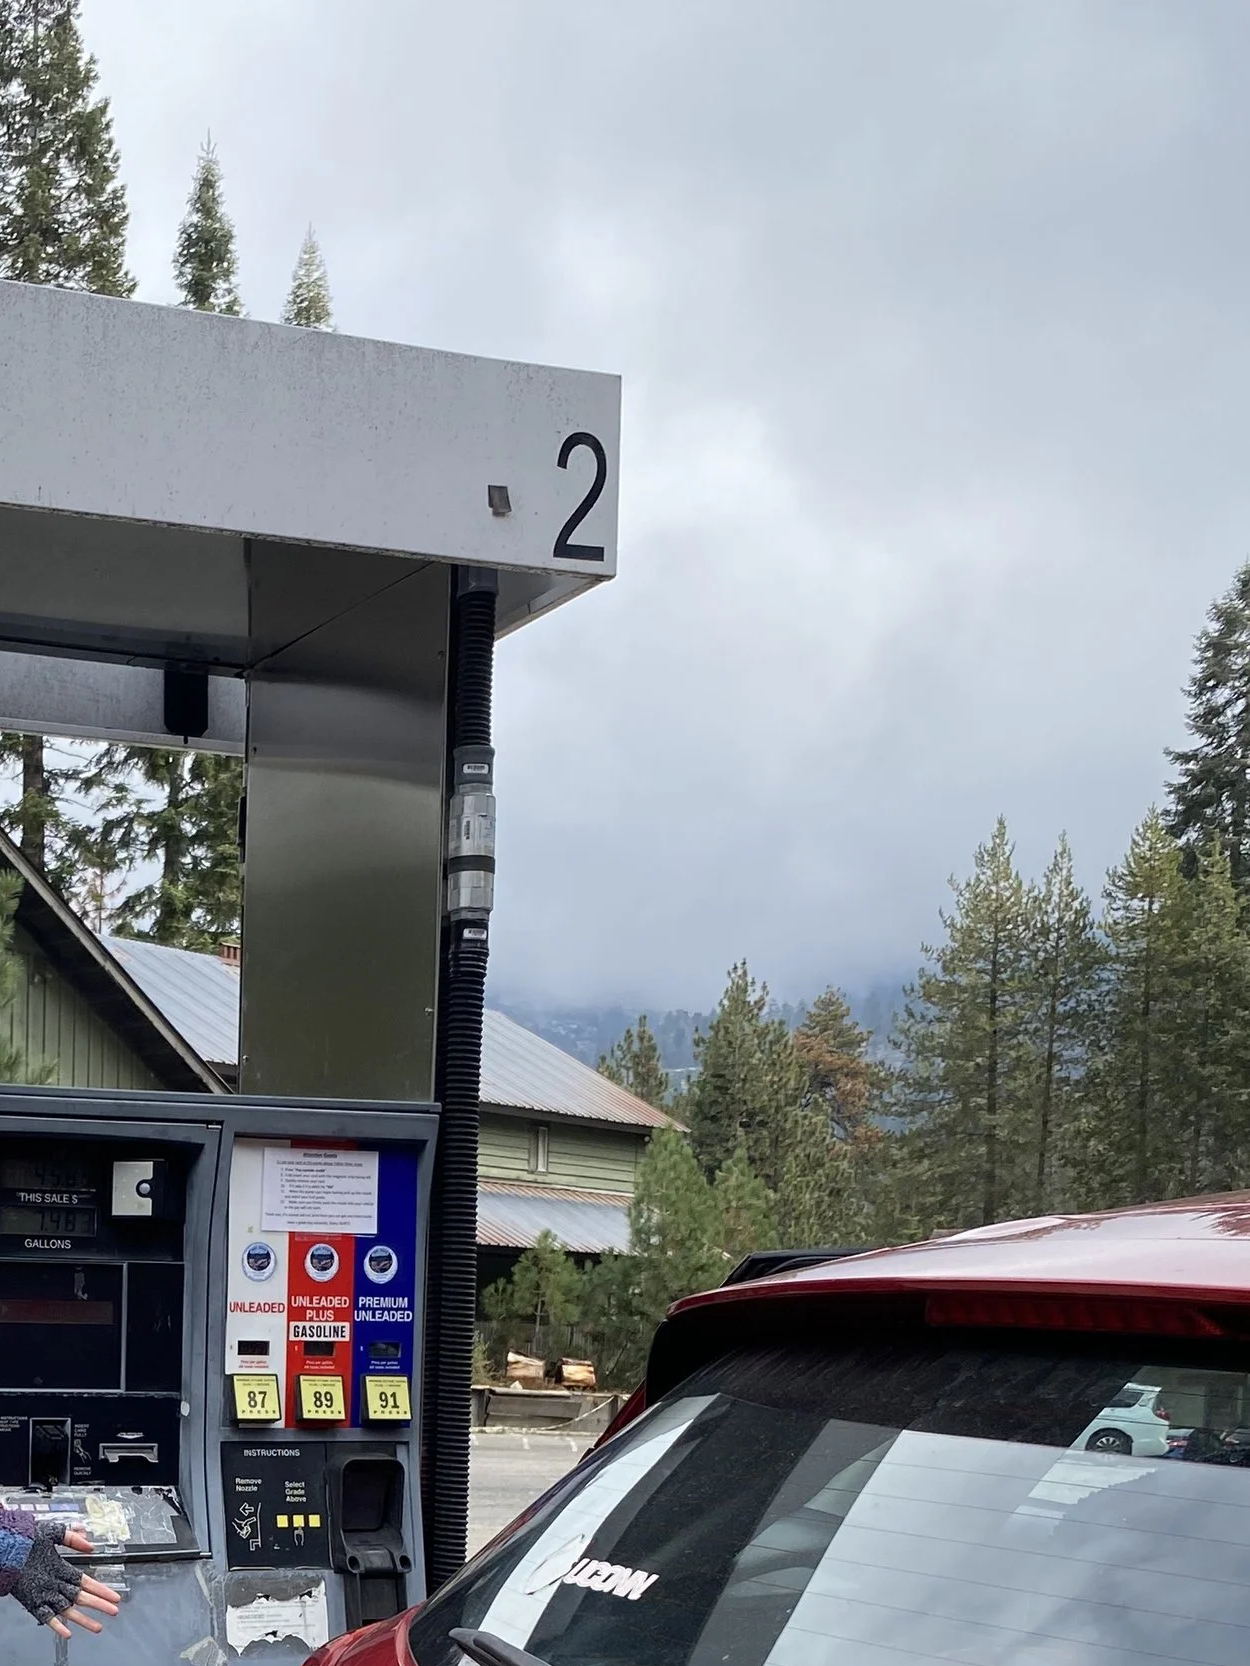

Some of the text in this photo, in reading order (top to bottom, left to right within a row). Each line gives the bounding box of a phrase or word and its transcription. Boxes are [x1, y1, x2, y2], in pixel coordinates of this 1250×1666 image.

[553, 432, 607, 562] 2
[20, 1192, 42, 1203] THIS
[44, 1193, 69, 1204] SALE
[24, 1239, 71, 1249] GALLONS
[230, 1302, 285, 1313] UNLEADED
[291, 1296, 349, 1308] UNLEADED
[358, 1297, 408, 1308] PREMIUM
[306, 1310, 334, 1321] PLUS
[354, 1310, 412, 1322] UNLEADED
[293, 1325, 346, 1338] GASOLINE
[247, 1391, 267, 1408] 87
[313, 1391, 333, 1408] 89
[379, 1391, 400, 1409] 91
[244, 1449, 300, 1457] INSTRUCTIONS
[563, 1558, 659, 1600] UCONN
